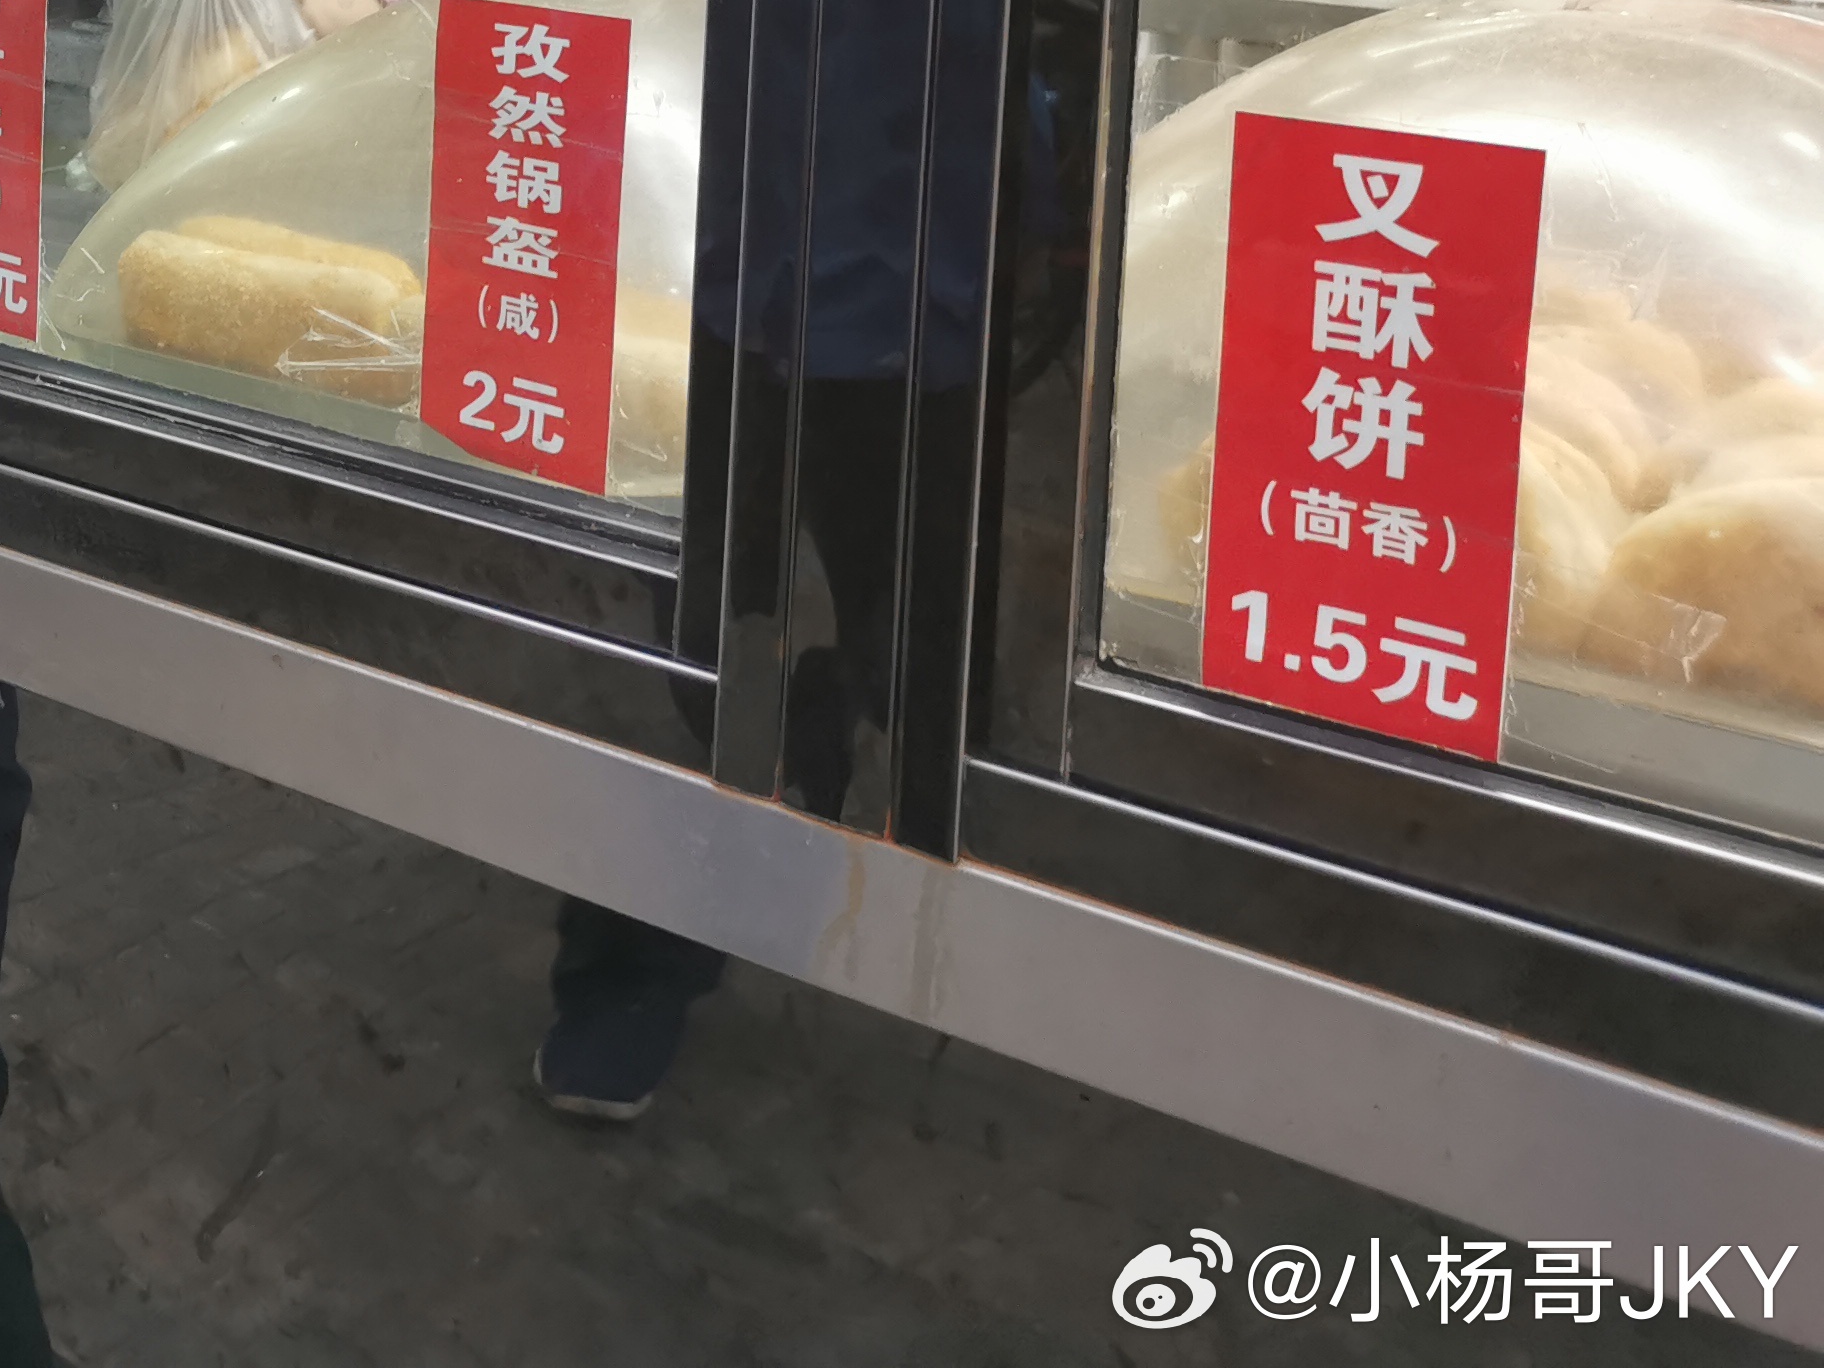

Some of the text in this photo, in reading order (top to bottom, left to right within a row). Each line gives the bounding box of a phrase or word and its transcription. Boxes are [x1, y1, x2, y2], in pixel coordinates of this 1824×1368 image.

[481, 21, 572, 280] 孜然锅盔
[478, 284, 560, 343] (咸)
[1300, 152, 1441, 481] 叉酥饼
[459, 369, 566, 455] 2元
[1259, 479, 1457, 573] (茴香)
[1230, 589, 1478, 722] 1.5元
